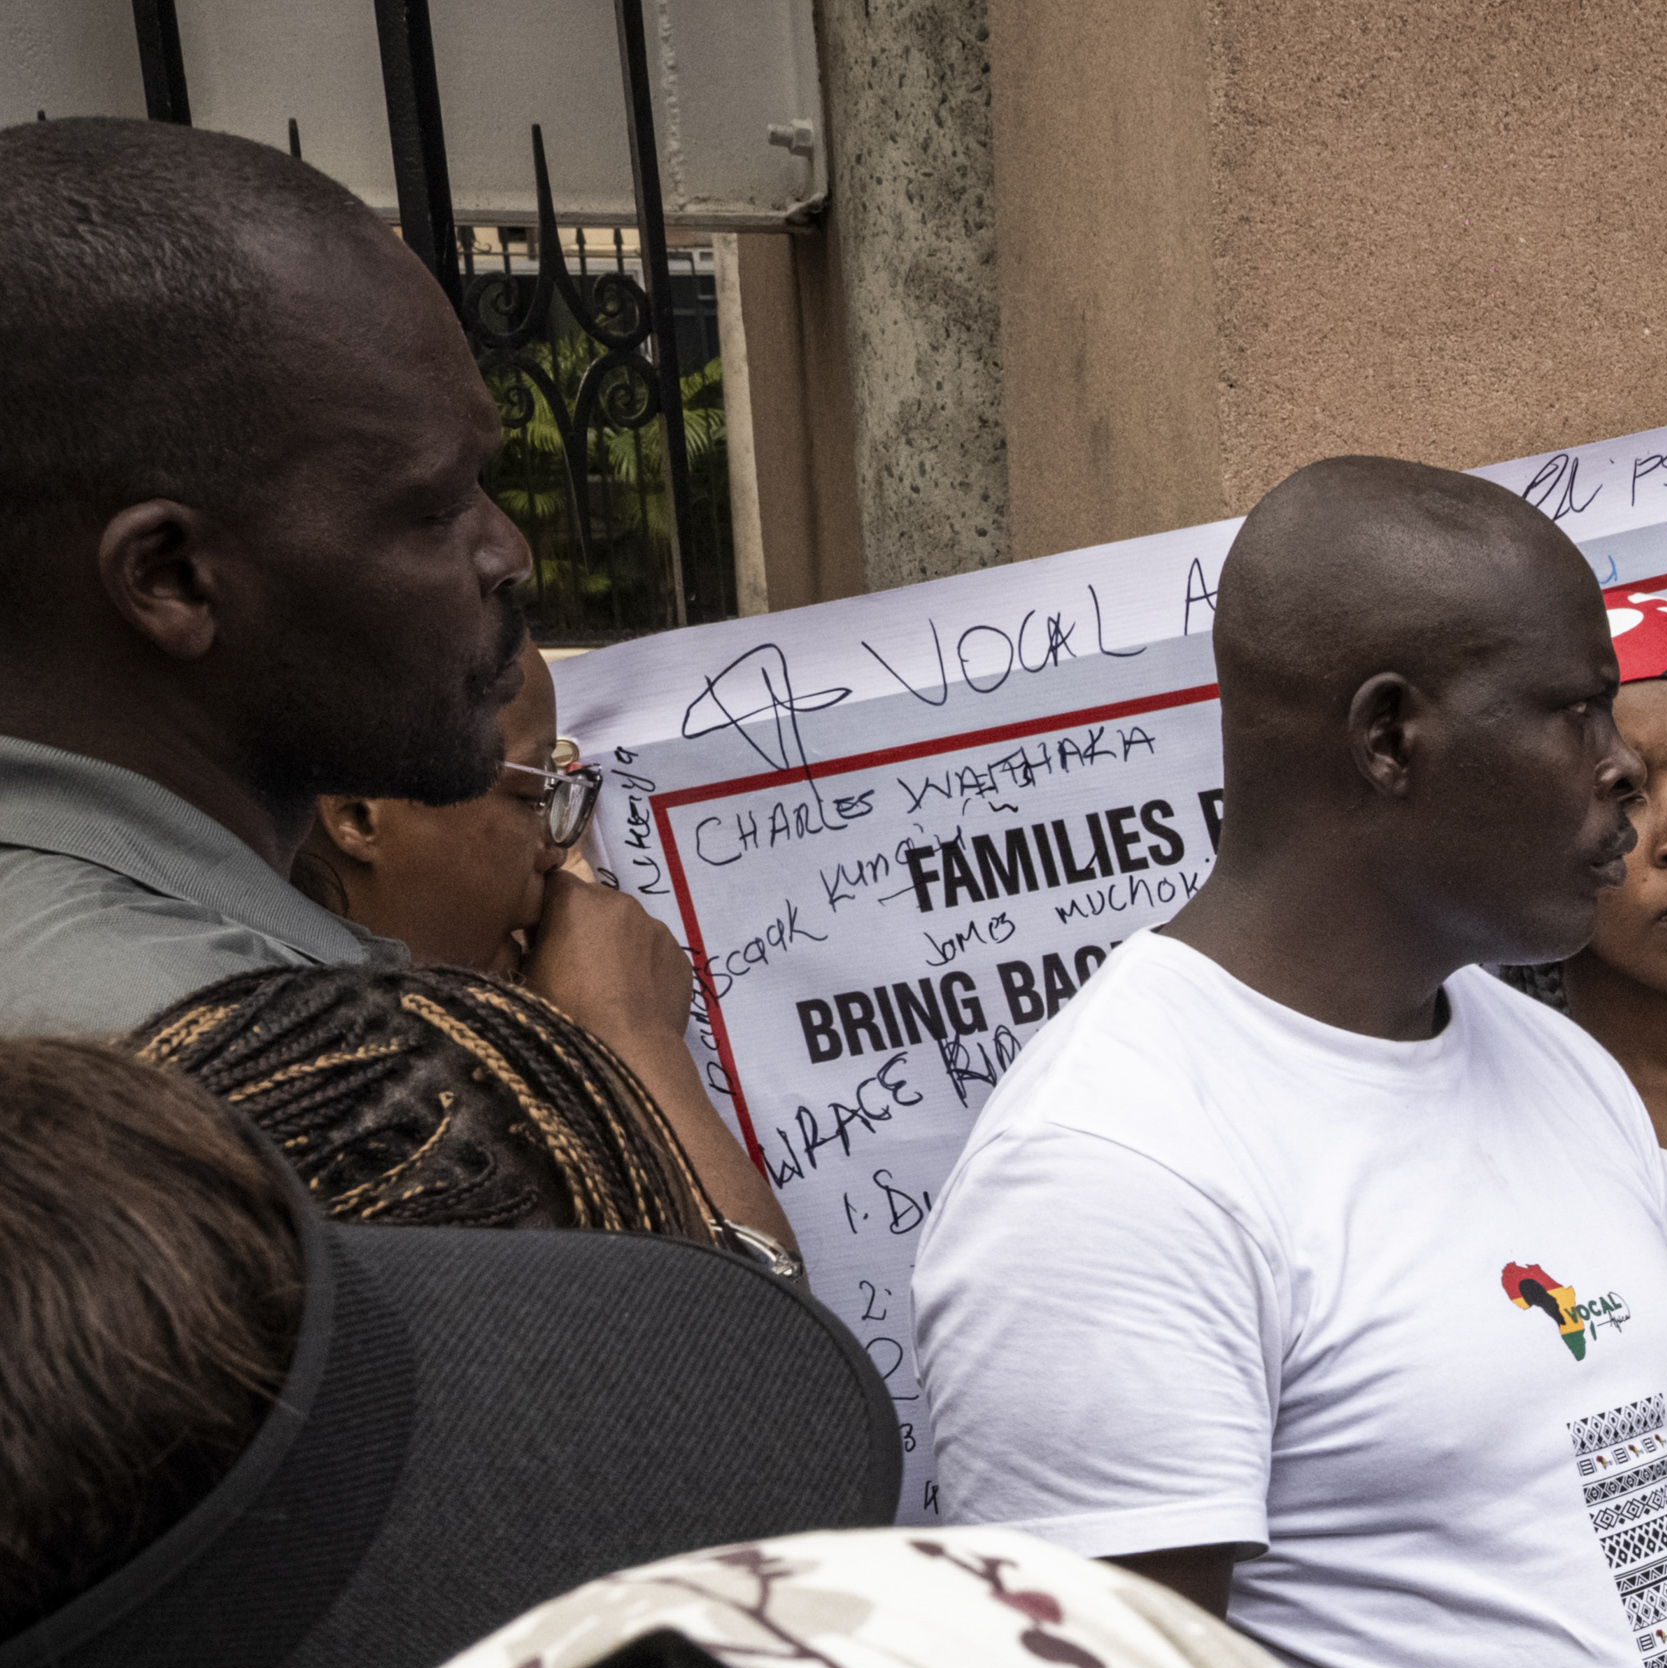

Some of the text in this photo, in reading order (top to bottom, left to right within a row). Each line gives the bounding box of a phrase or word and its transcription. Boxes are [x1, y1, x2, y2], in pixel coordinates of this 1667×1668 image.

[862, 584, 1147, 707] VOCAL
[904, 798, 1186, 914] FAMILIES
[795, 970, 989, 1065] BRING
[996, 940, 1126, 1028] BAC
[1563, 1293, 1623, 1324] VOCAL
